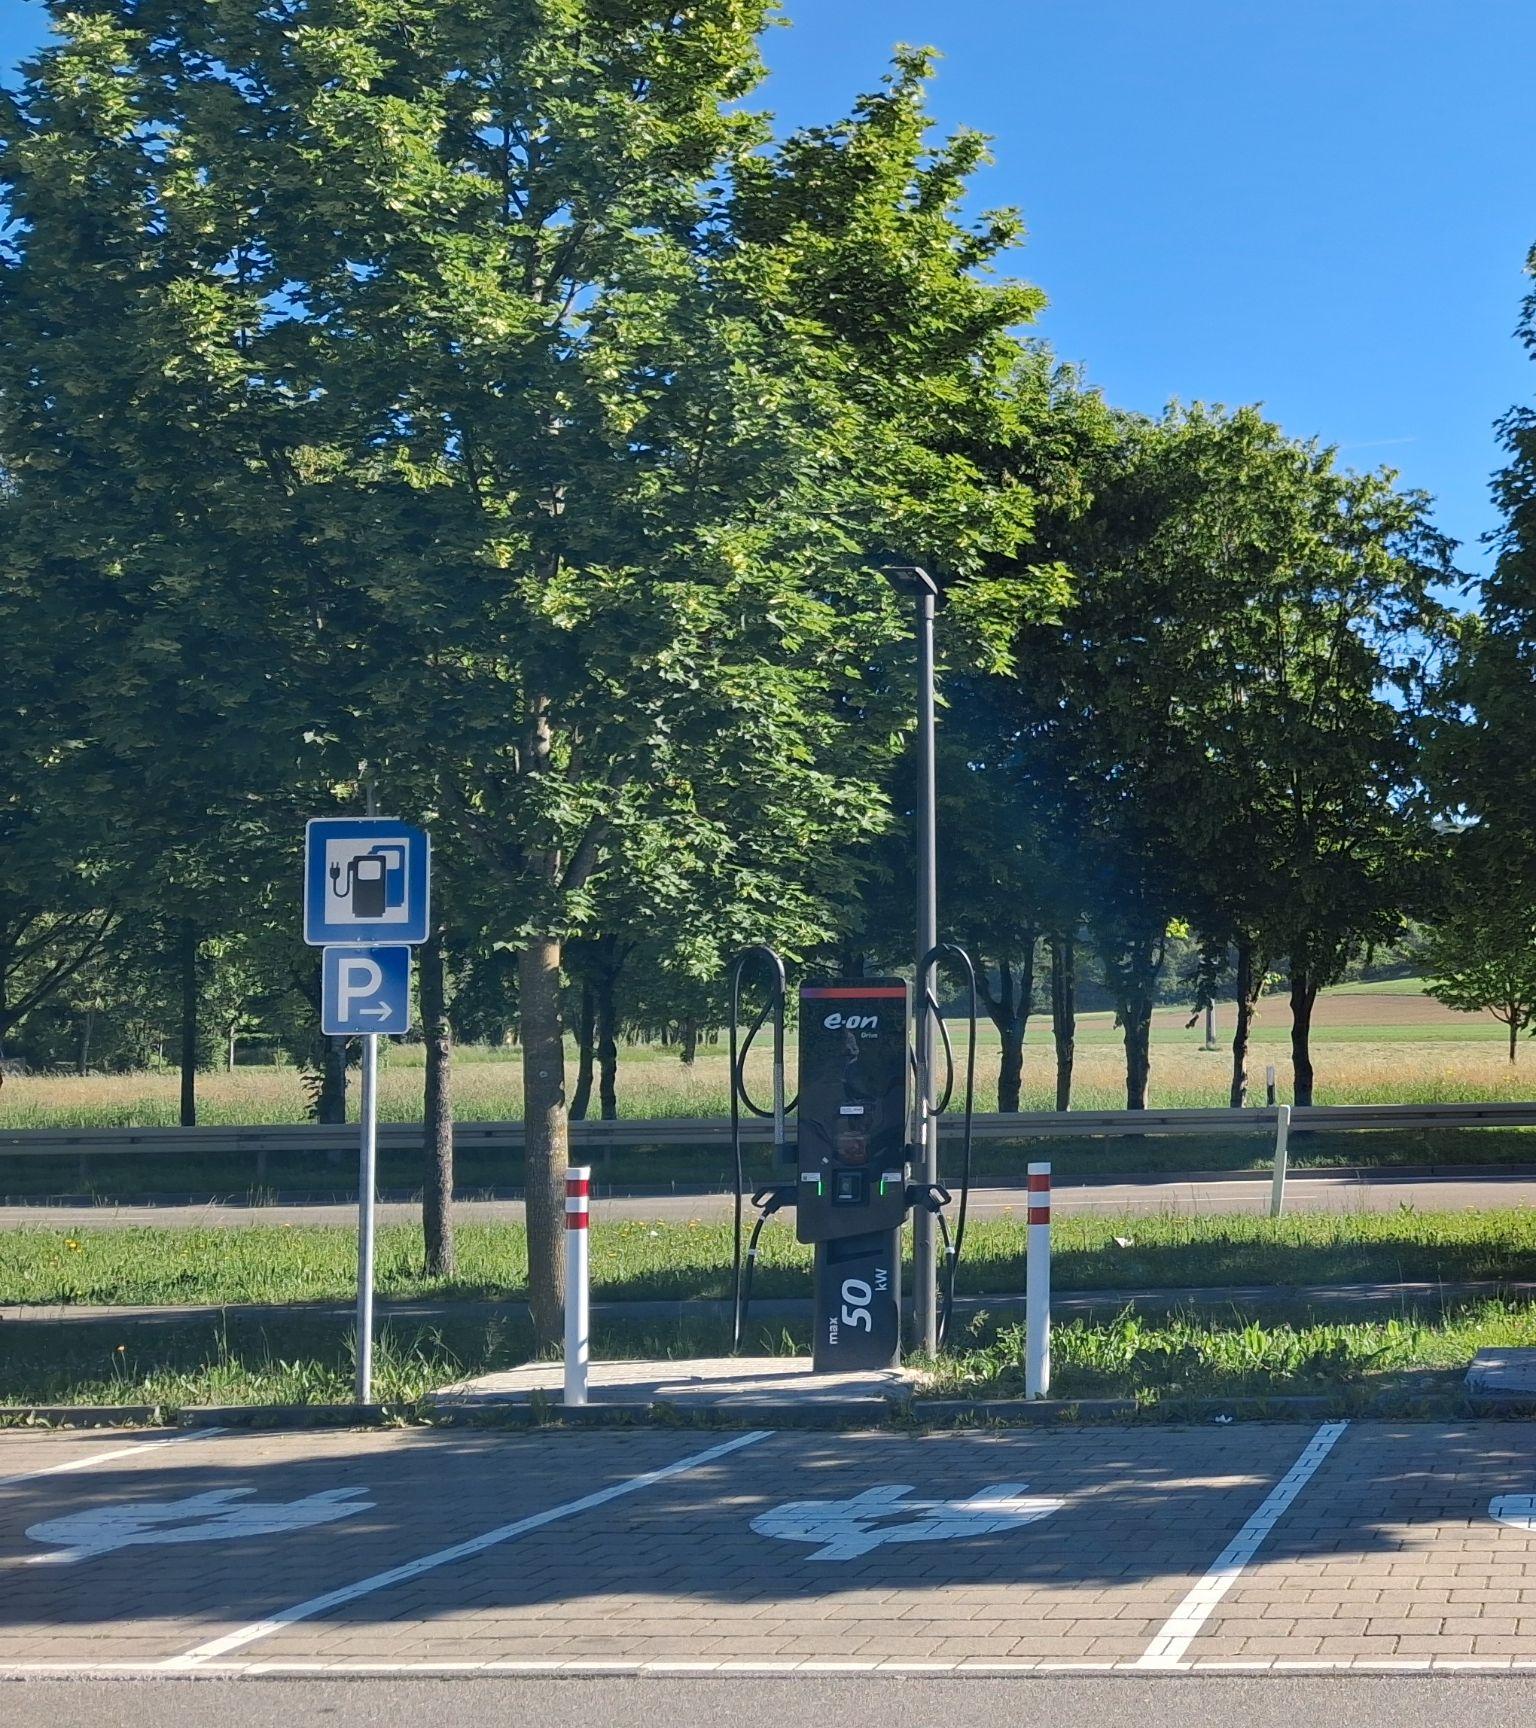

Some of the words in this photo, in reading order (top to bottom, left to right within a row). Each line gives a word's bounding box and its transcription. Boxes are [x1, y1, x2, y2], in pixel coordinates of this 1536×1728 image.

[337, 958, 383, 1023] P
[874, 1267, 888, 1291] kW
[841, 1278, 872, 1333] 50
[828, 1316, 839, 1345] max
